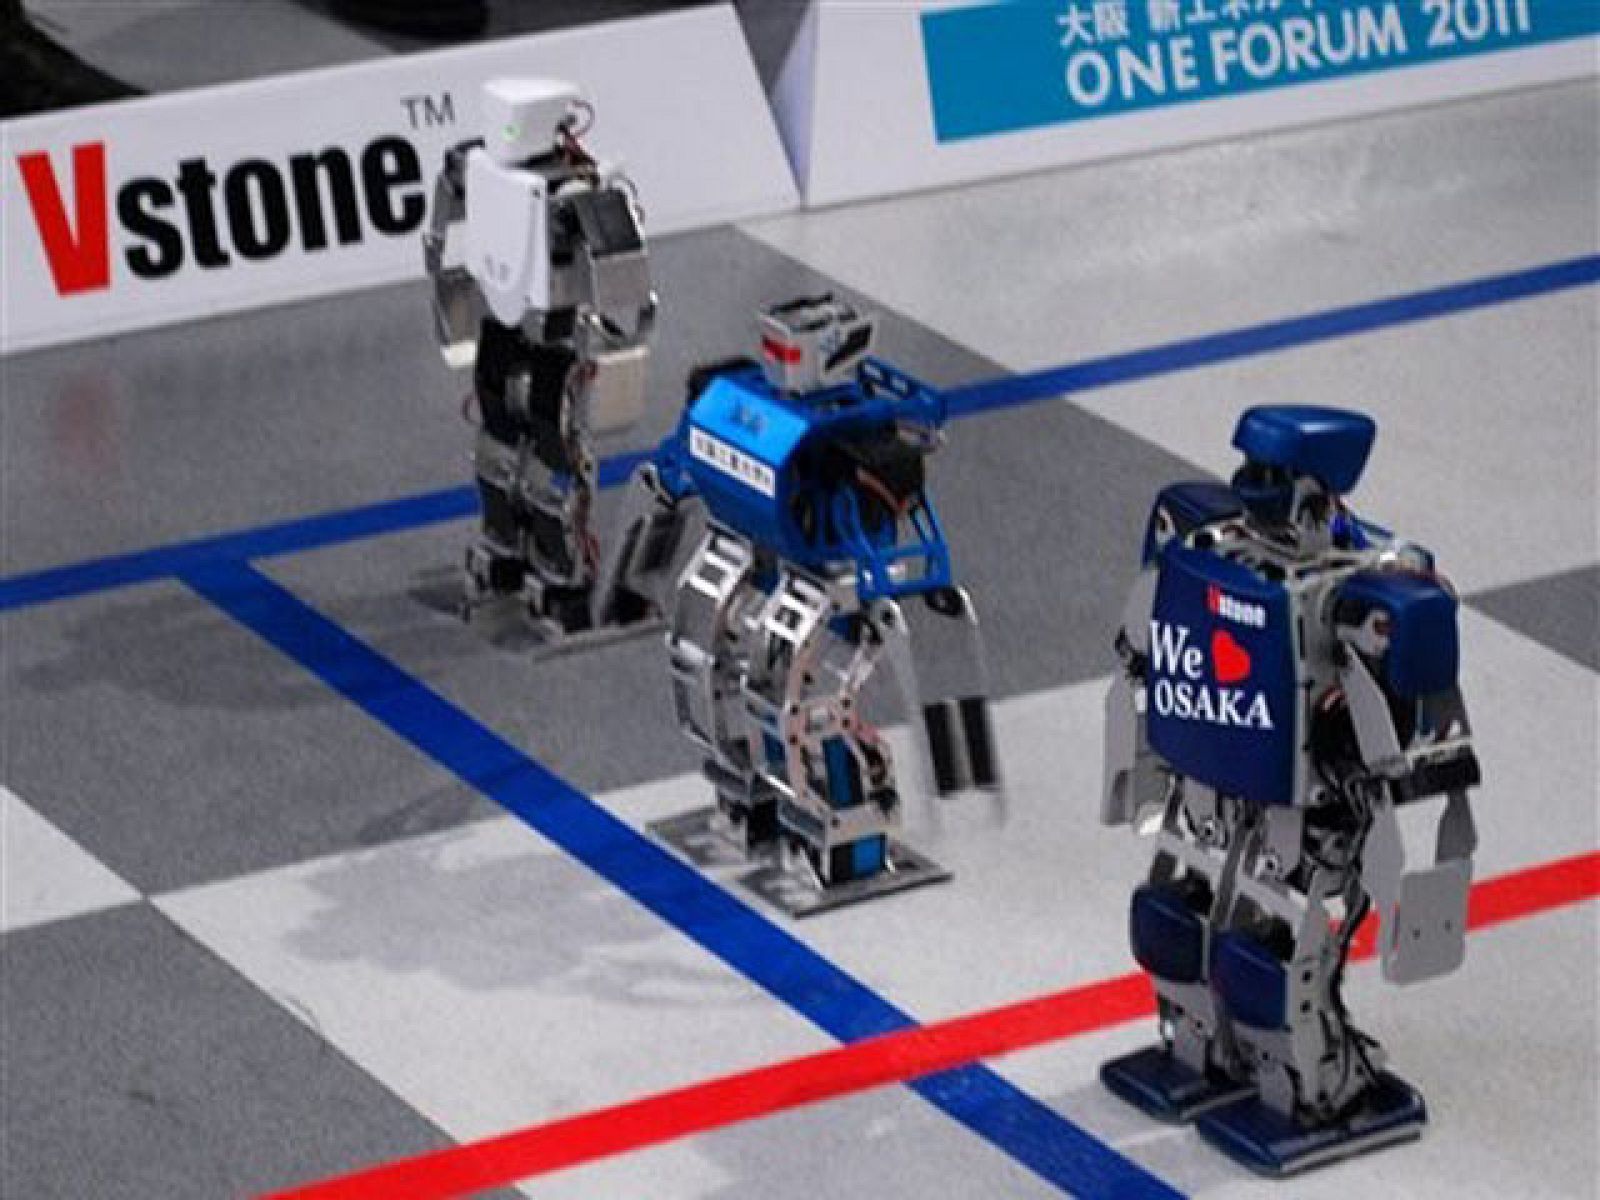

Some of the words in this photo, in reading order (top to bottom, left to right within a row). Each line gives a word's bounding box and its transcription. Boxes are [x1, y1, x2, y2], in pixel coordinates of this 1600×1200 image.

[1066, 37, 1200, 107] ONE
[1209, 3, 1408, 85] FORUM
[1420, 0, 1531, 47] 2011
[401, 92, 456, 130] TM
[16, 135, 427, 297] Vstone
[1150, 619, 1203, 679] We
[1154, 677, 1275, 730] OSAKA
